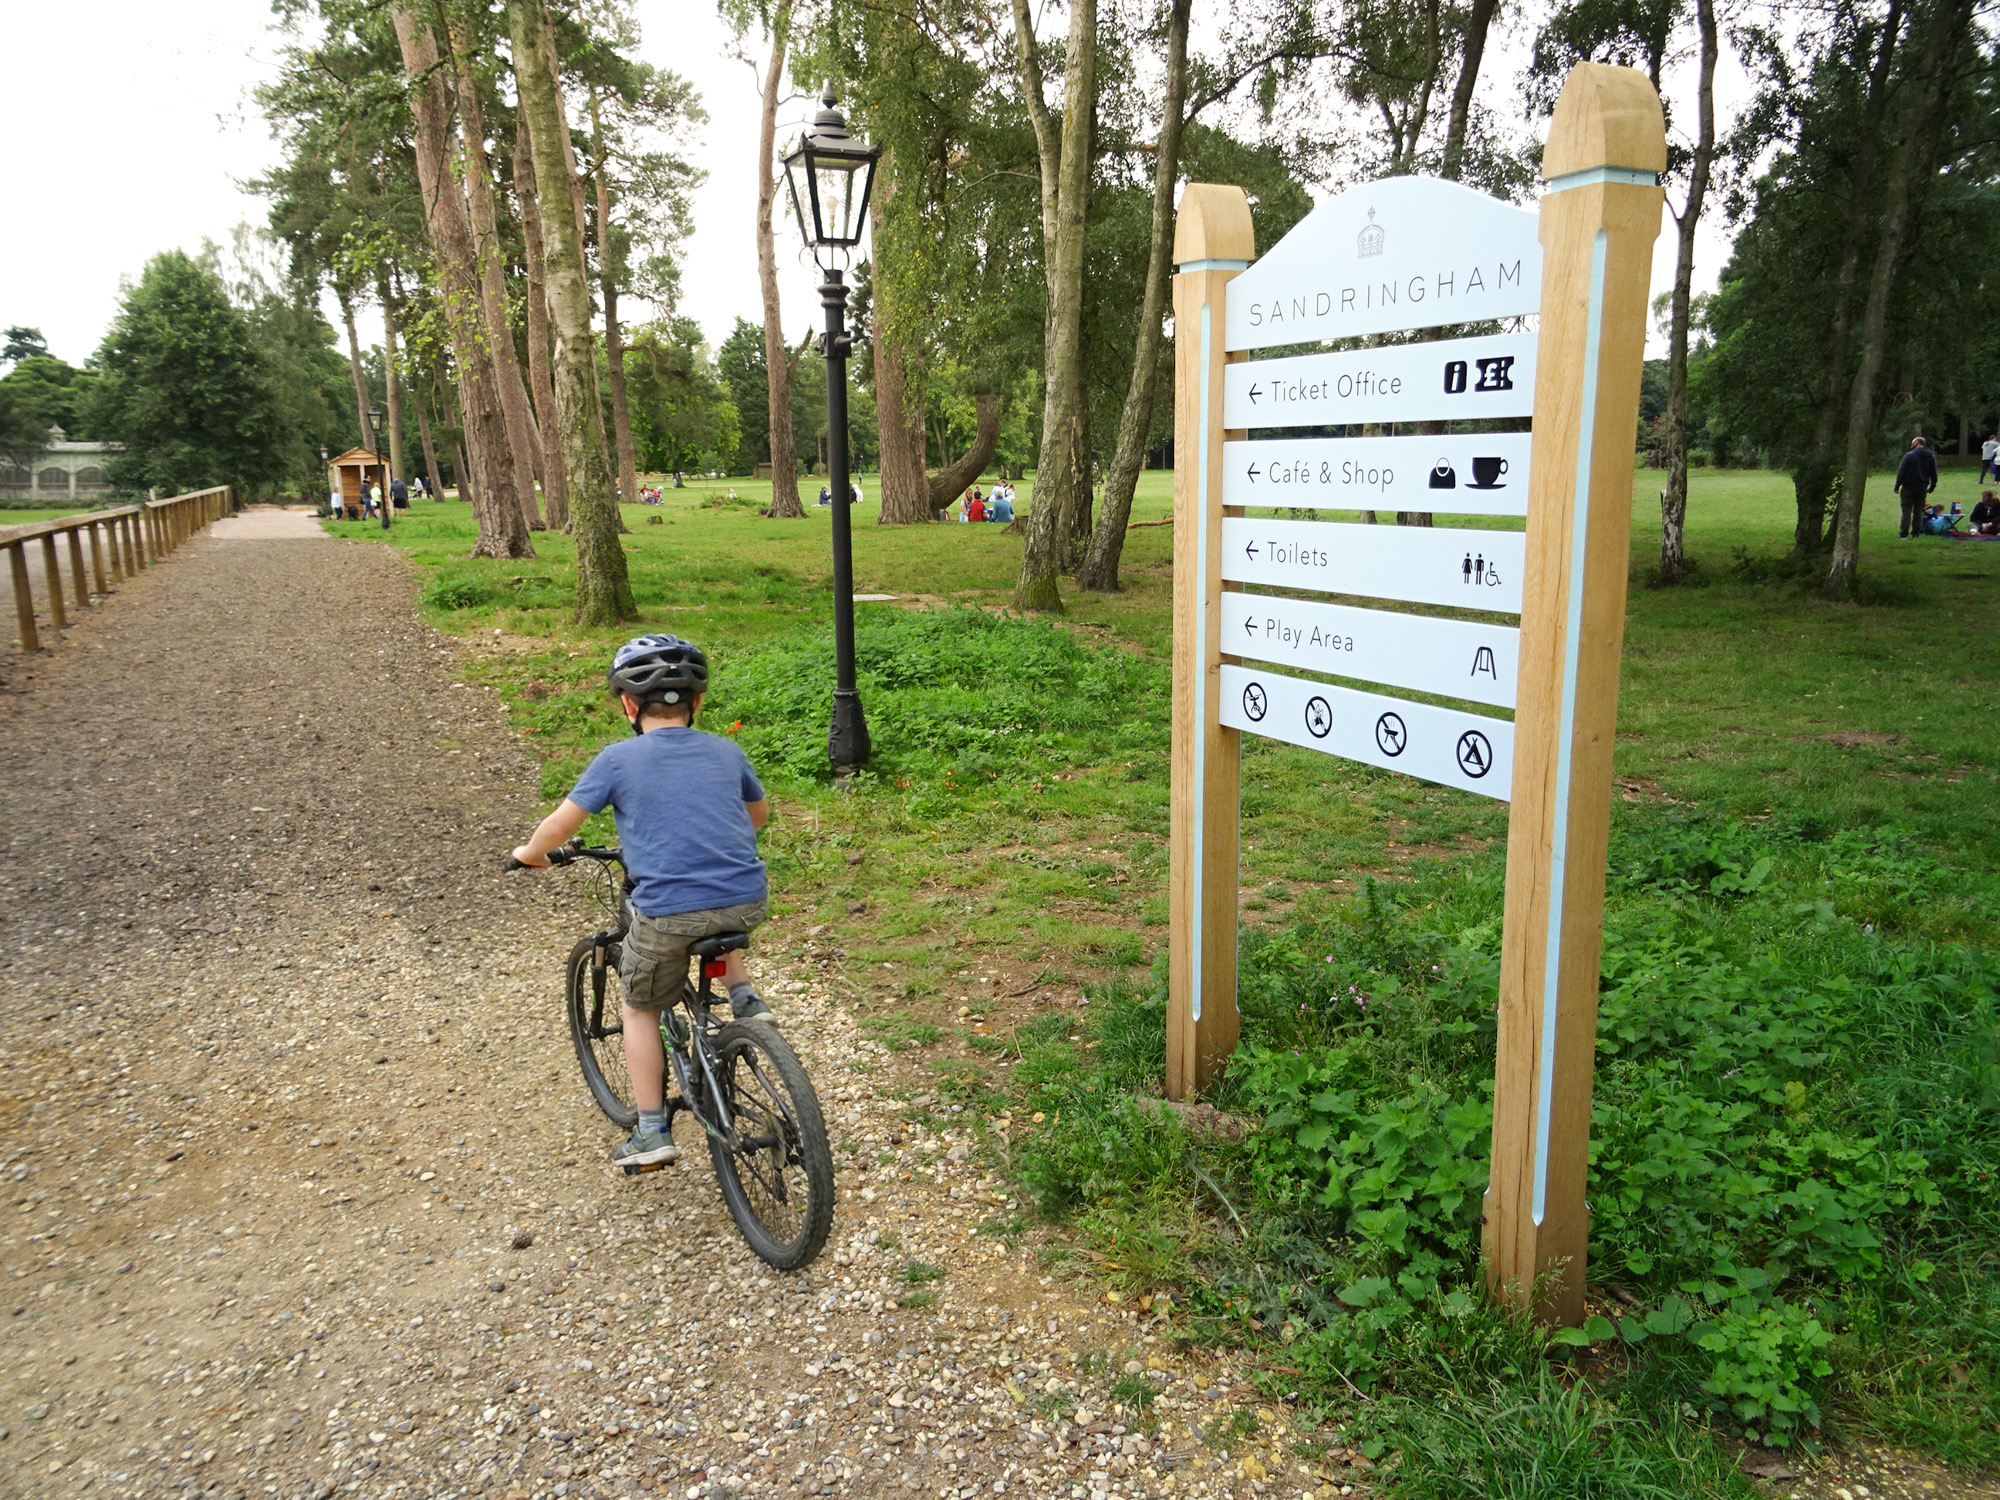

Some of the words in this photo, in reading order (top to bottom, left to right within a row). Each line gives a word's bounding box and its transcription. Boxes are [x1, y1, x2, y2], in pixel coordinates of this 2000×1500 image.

[1249, 259, 1522, 327] SANDRINGHAM
[1271, 376, 1328, 402] Ticket
[1337, 371, 1402, 398] Office
[1269, 461, 1311, 485] Café
[1319, 462, 1332, 485] &
[1341, 461, 1394, 493] Shop
[1267, 541, 1328, 568] Toilets
[1266, 618, 1302, 649] Play
[1309, 625, 1354, 652] Area
